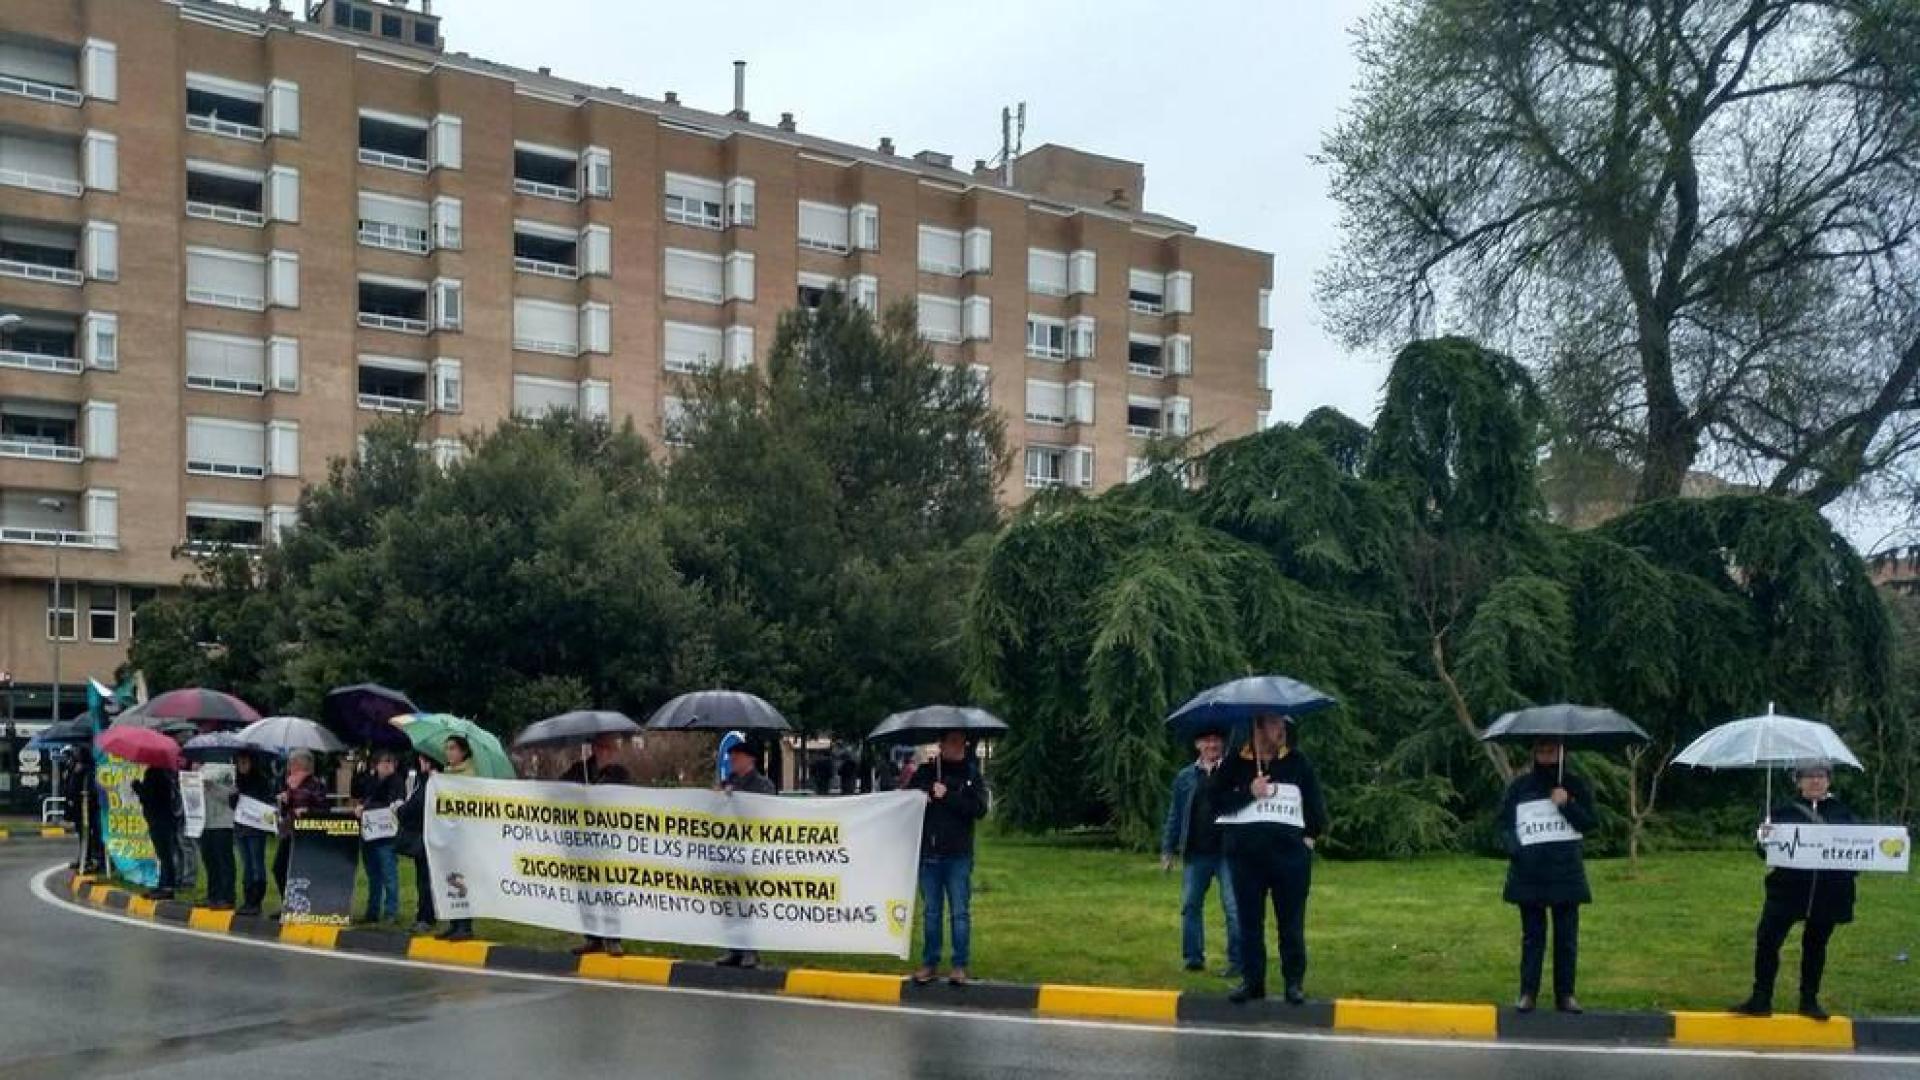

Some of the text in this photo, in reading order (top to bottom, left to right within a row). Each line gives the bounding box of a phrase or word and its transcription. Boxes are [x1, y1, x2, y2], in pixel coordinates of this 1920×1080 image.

[436, 798, 839, 844] LARRIKI GAIXORIK DAUDEN PRESOAK KALERA!
[502, 824, 850, 866] POR LA LIBERTAD DE LXS PRESXS ENFERMXS
[1822, 846, 1874, 860] etxera!
[520, 858, 835, 900] ZIGORREN LUZAPENAREN KONTRA!
[501, 879, 878, 924] CONTRA EL ALARGAMIENTO DE LAS CONDENAS
